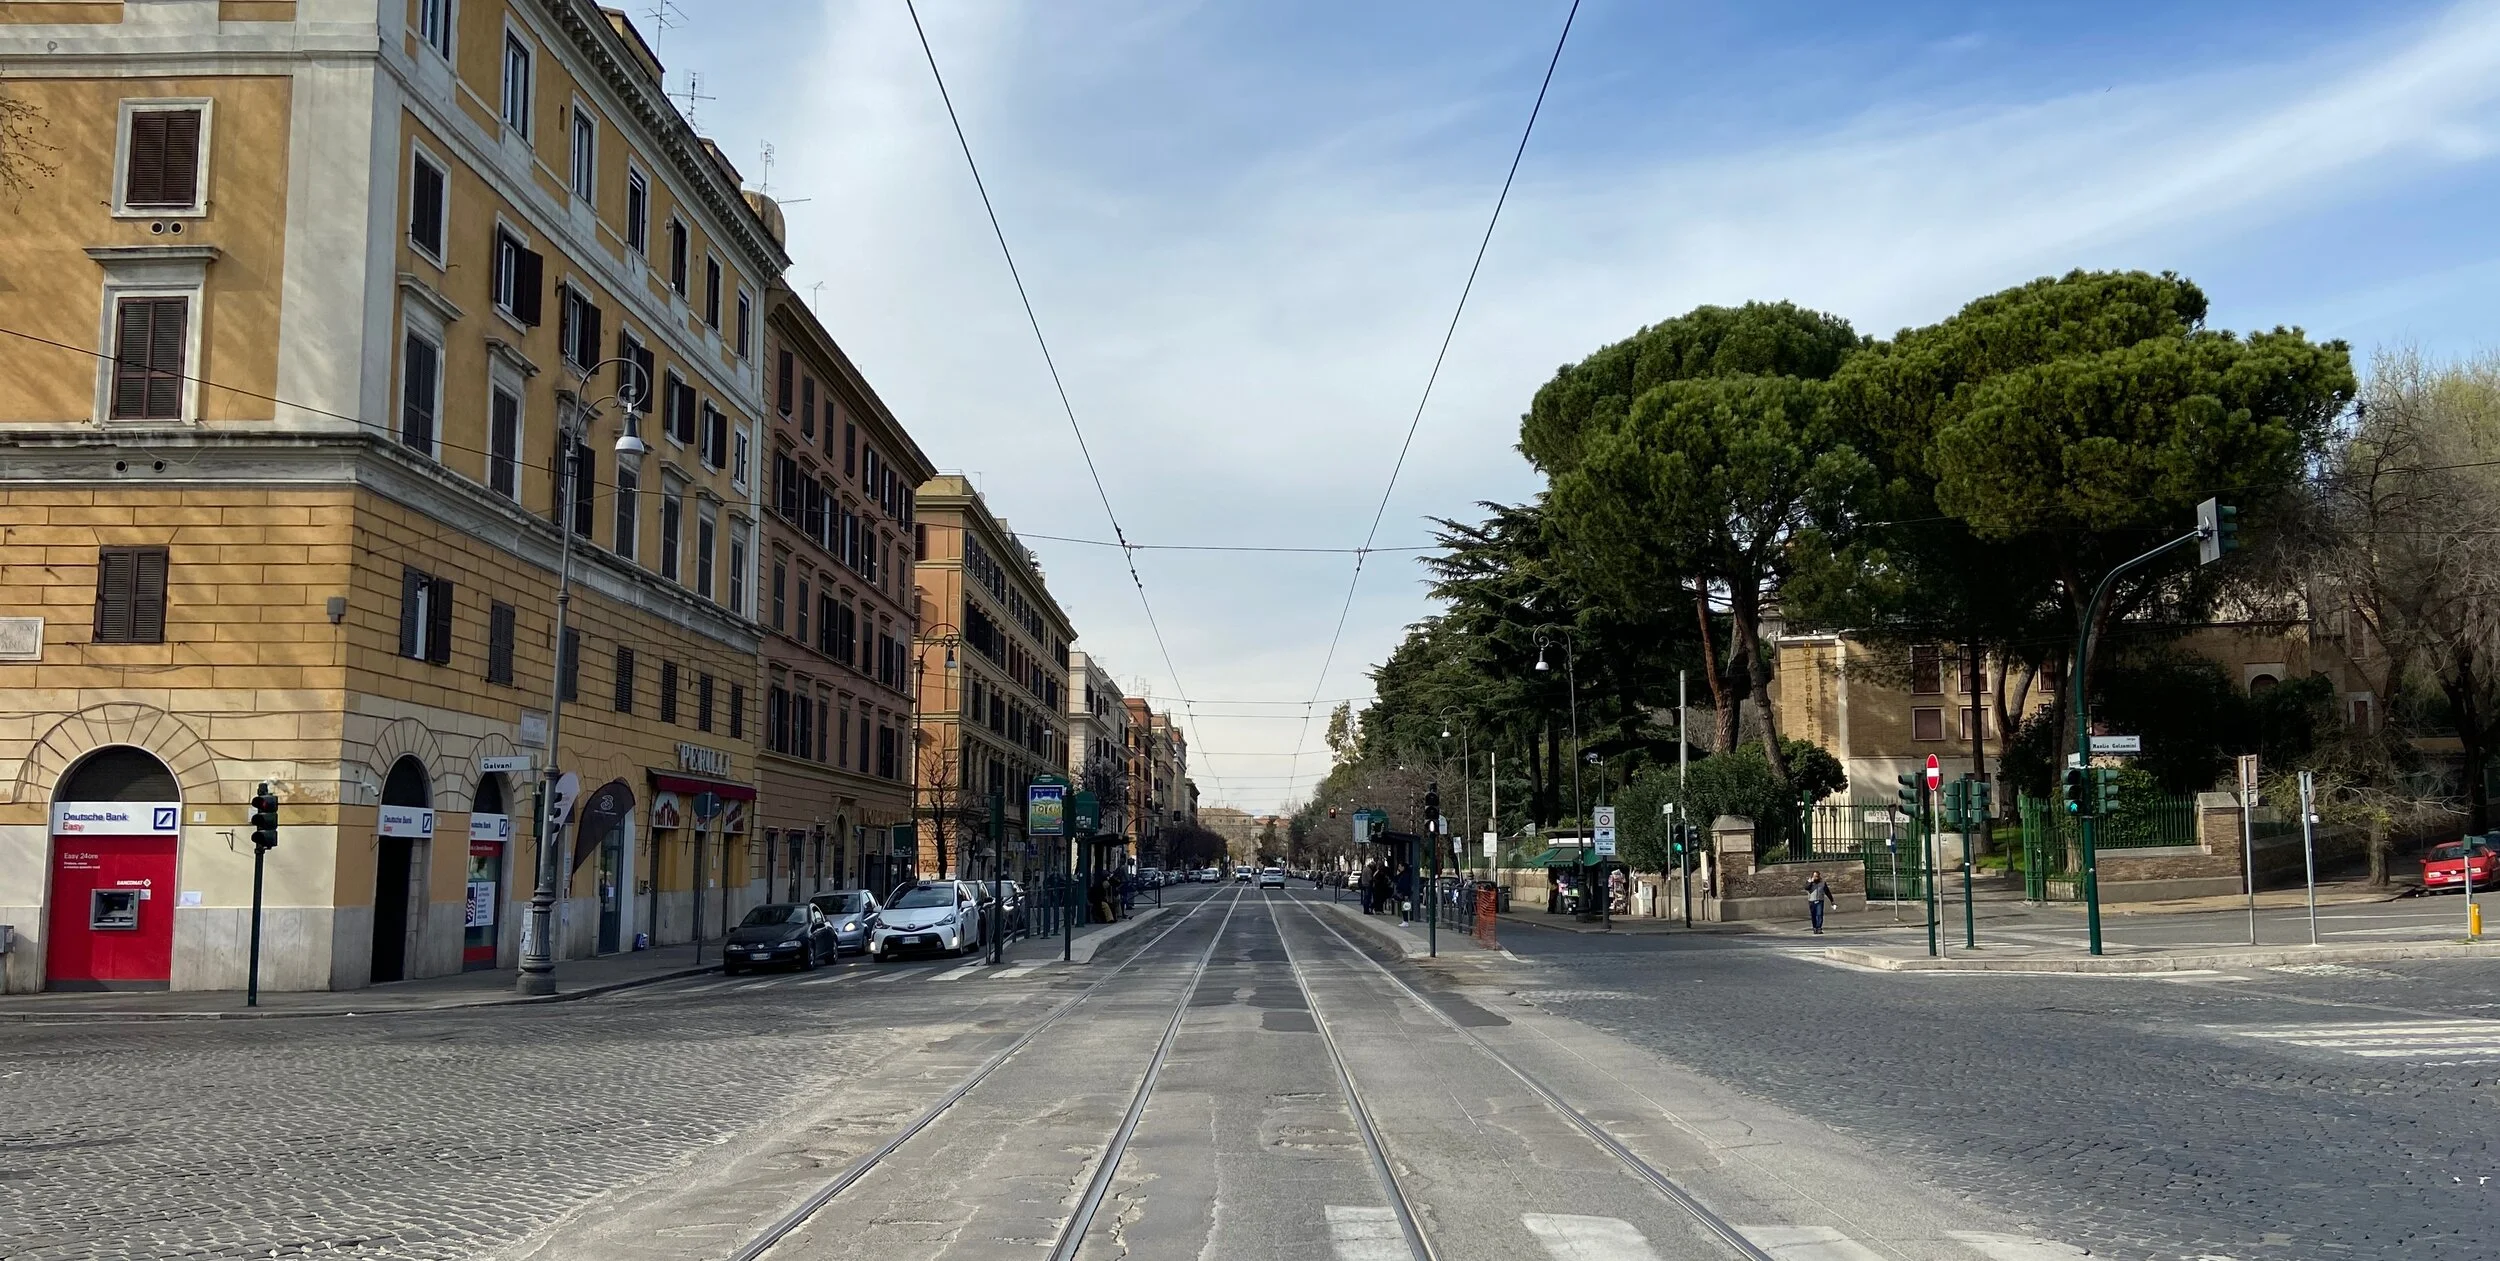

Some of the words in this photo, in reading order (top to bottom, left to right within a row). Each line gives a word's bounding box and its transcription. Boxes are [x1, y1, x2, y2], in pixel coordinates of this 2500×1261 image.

[483, 762, 512, 770] Galvani
[63, 812, 104, 821] Deutsche
[105, 812, 129, 821] Bank
[384, 814, 402, 824] Deutsche
[402, 815, 412, 825] Bank
[62, 822, 84, 832] Easy
[63, 852, 79, 860] Easy
